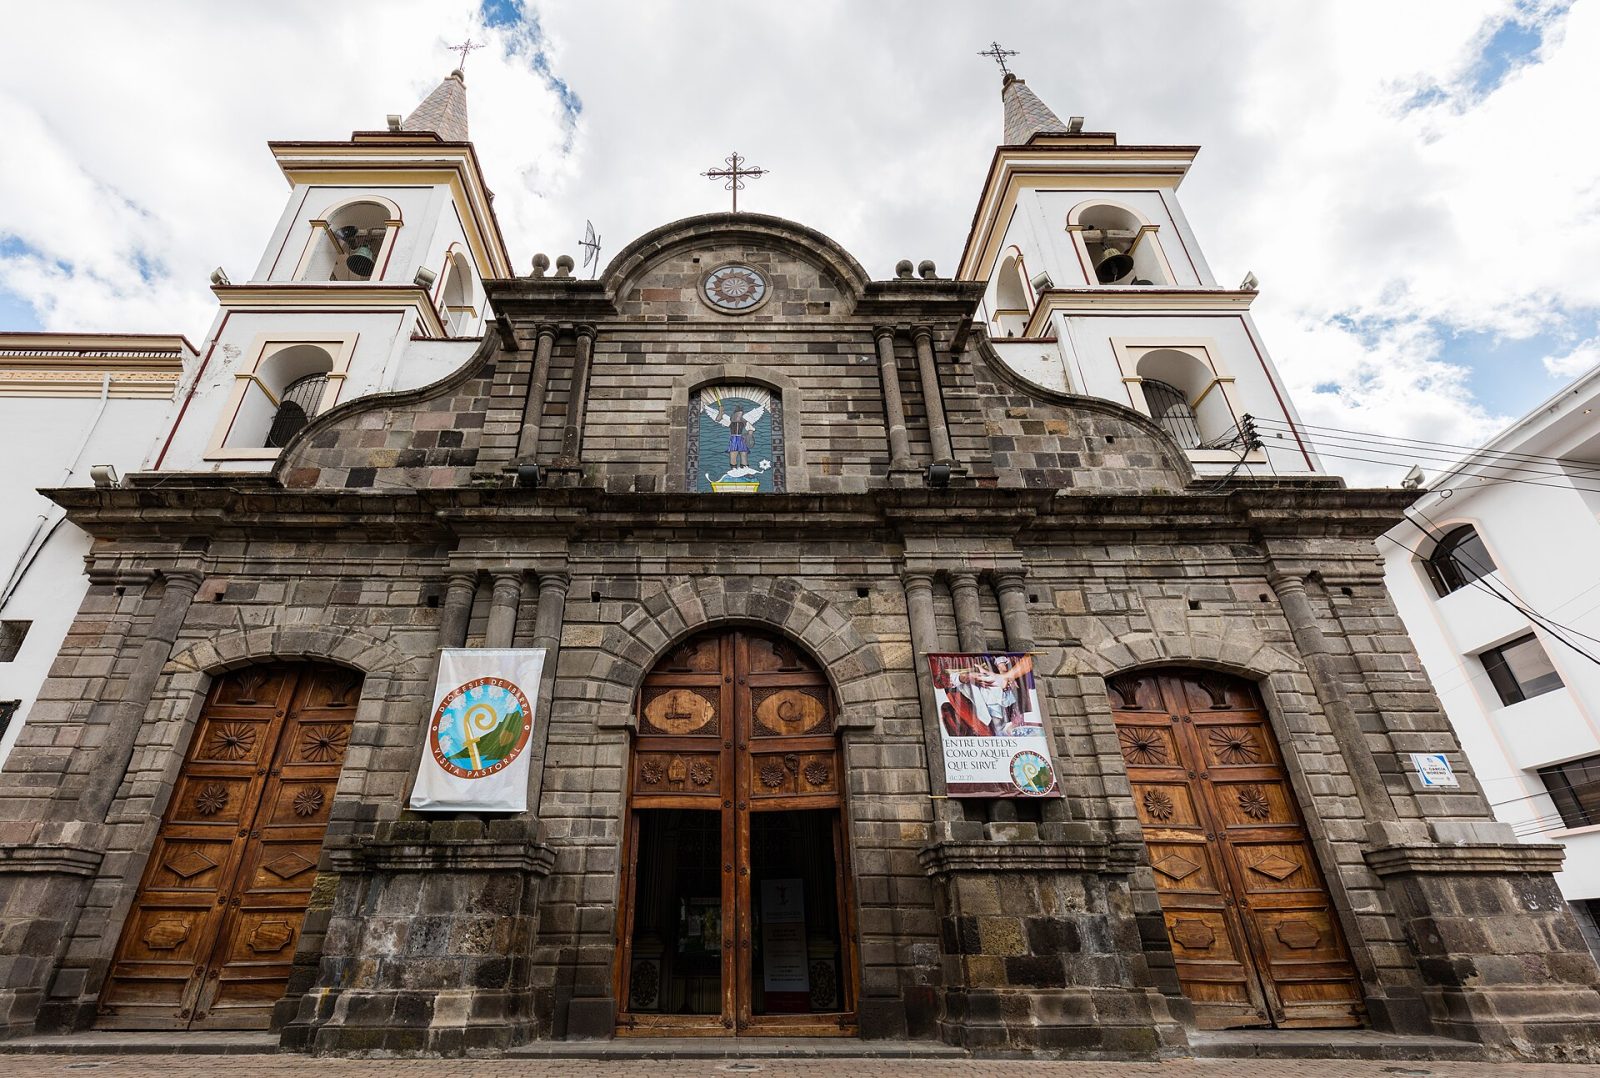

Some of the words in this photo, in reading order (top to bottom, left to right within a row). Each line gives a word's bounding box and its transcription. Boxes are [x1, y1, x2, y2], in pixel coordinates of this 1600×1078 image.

[439, 679, 484, 713] DIOCESIS
[491, 679, 503, 687] DE
[507, 685, 529, 716] IBARRA
[978, 738, 1018, 748] USTEDES
[945, 749, 978, 758] COMO
[980, 749, 1011, 759] AQUEL
[434, 747, 460, 775] VISITA
[467, 747, 521, 777] PASTORAL
[947, 760, 969, 771] QUE
